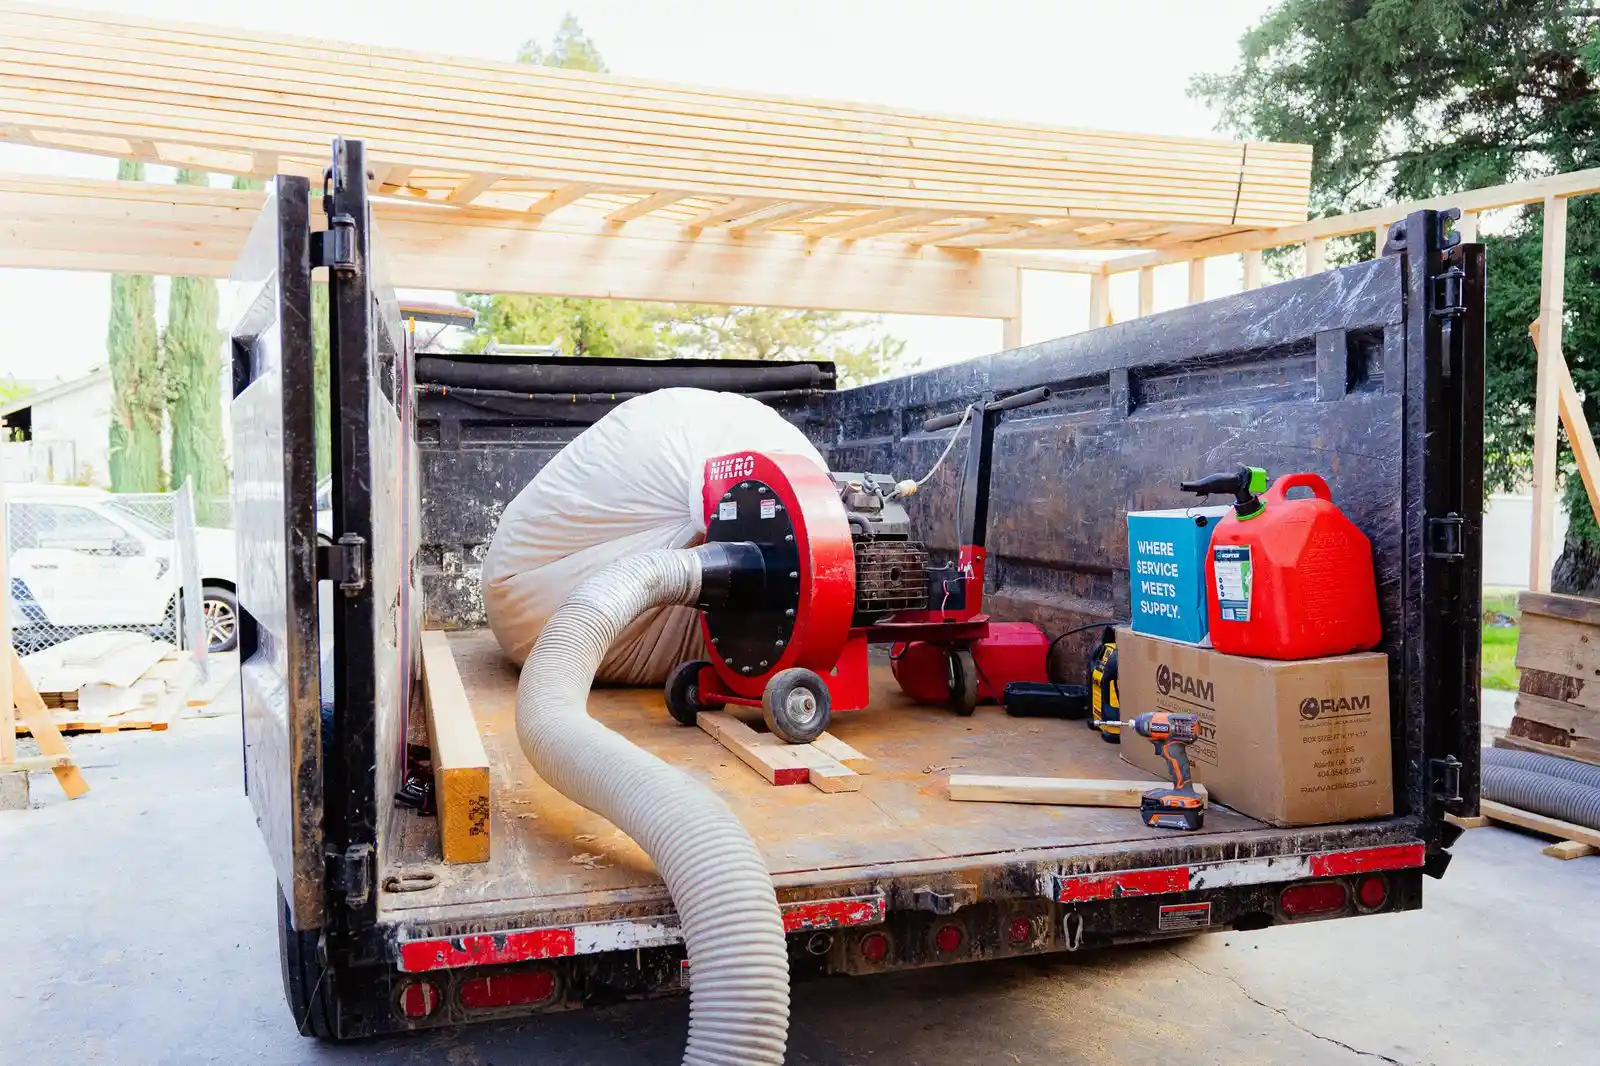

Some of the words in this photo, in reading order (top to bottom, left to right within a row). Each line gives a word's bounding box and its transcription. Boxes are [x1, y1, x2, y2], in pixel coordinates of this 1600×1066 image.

[710, 455, 754, 480] NIKRO
[1137, 540, 1175, 556] WHERE
[1136, 560, 1179, 578] SERVICE
[1141, 580, 1176, 598] MEETS
[1140, 600, 1181, 619] SUPPLY.
[1172, 672, 1215, 702] RAM
[1320, 695, 1370, 713] RAM
[1302, 736, 1317, 744] BOX
